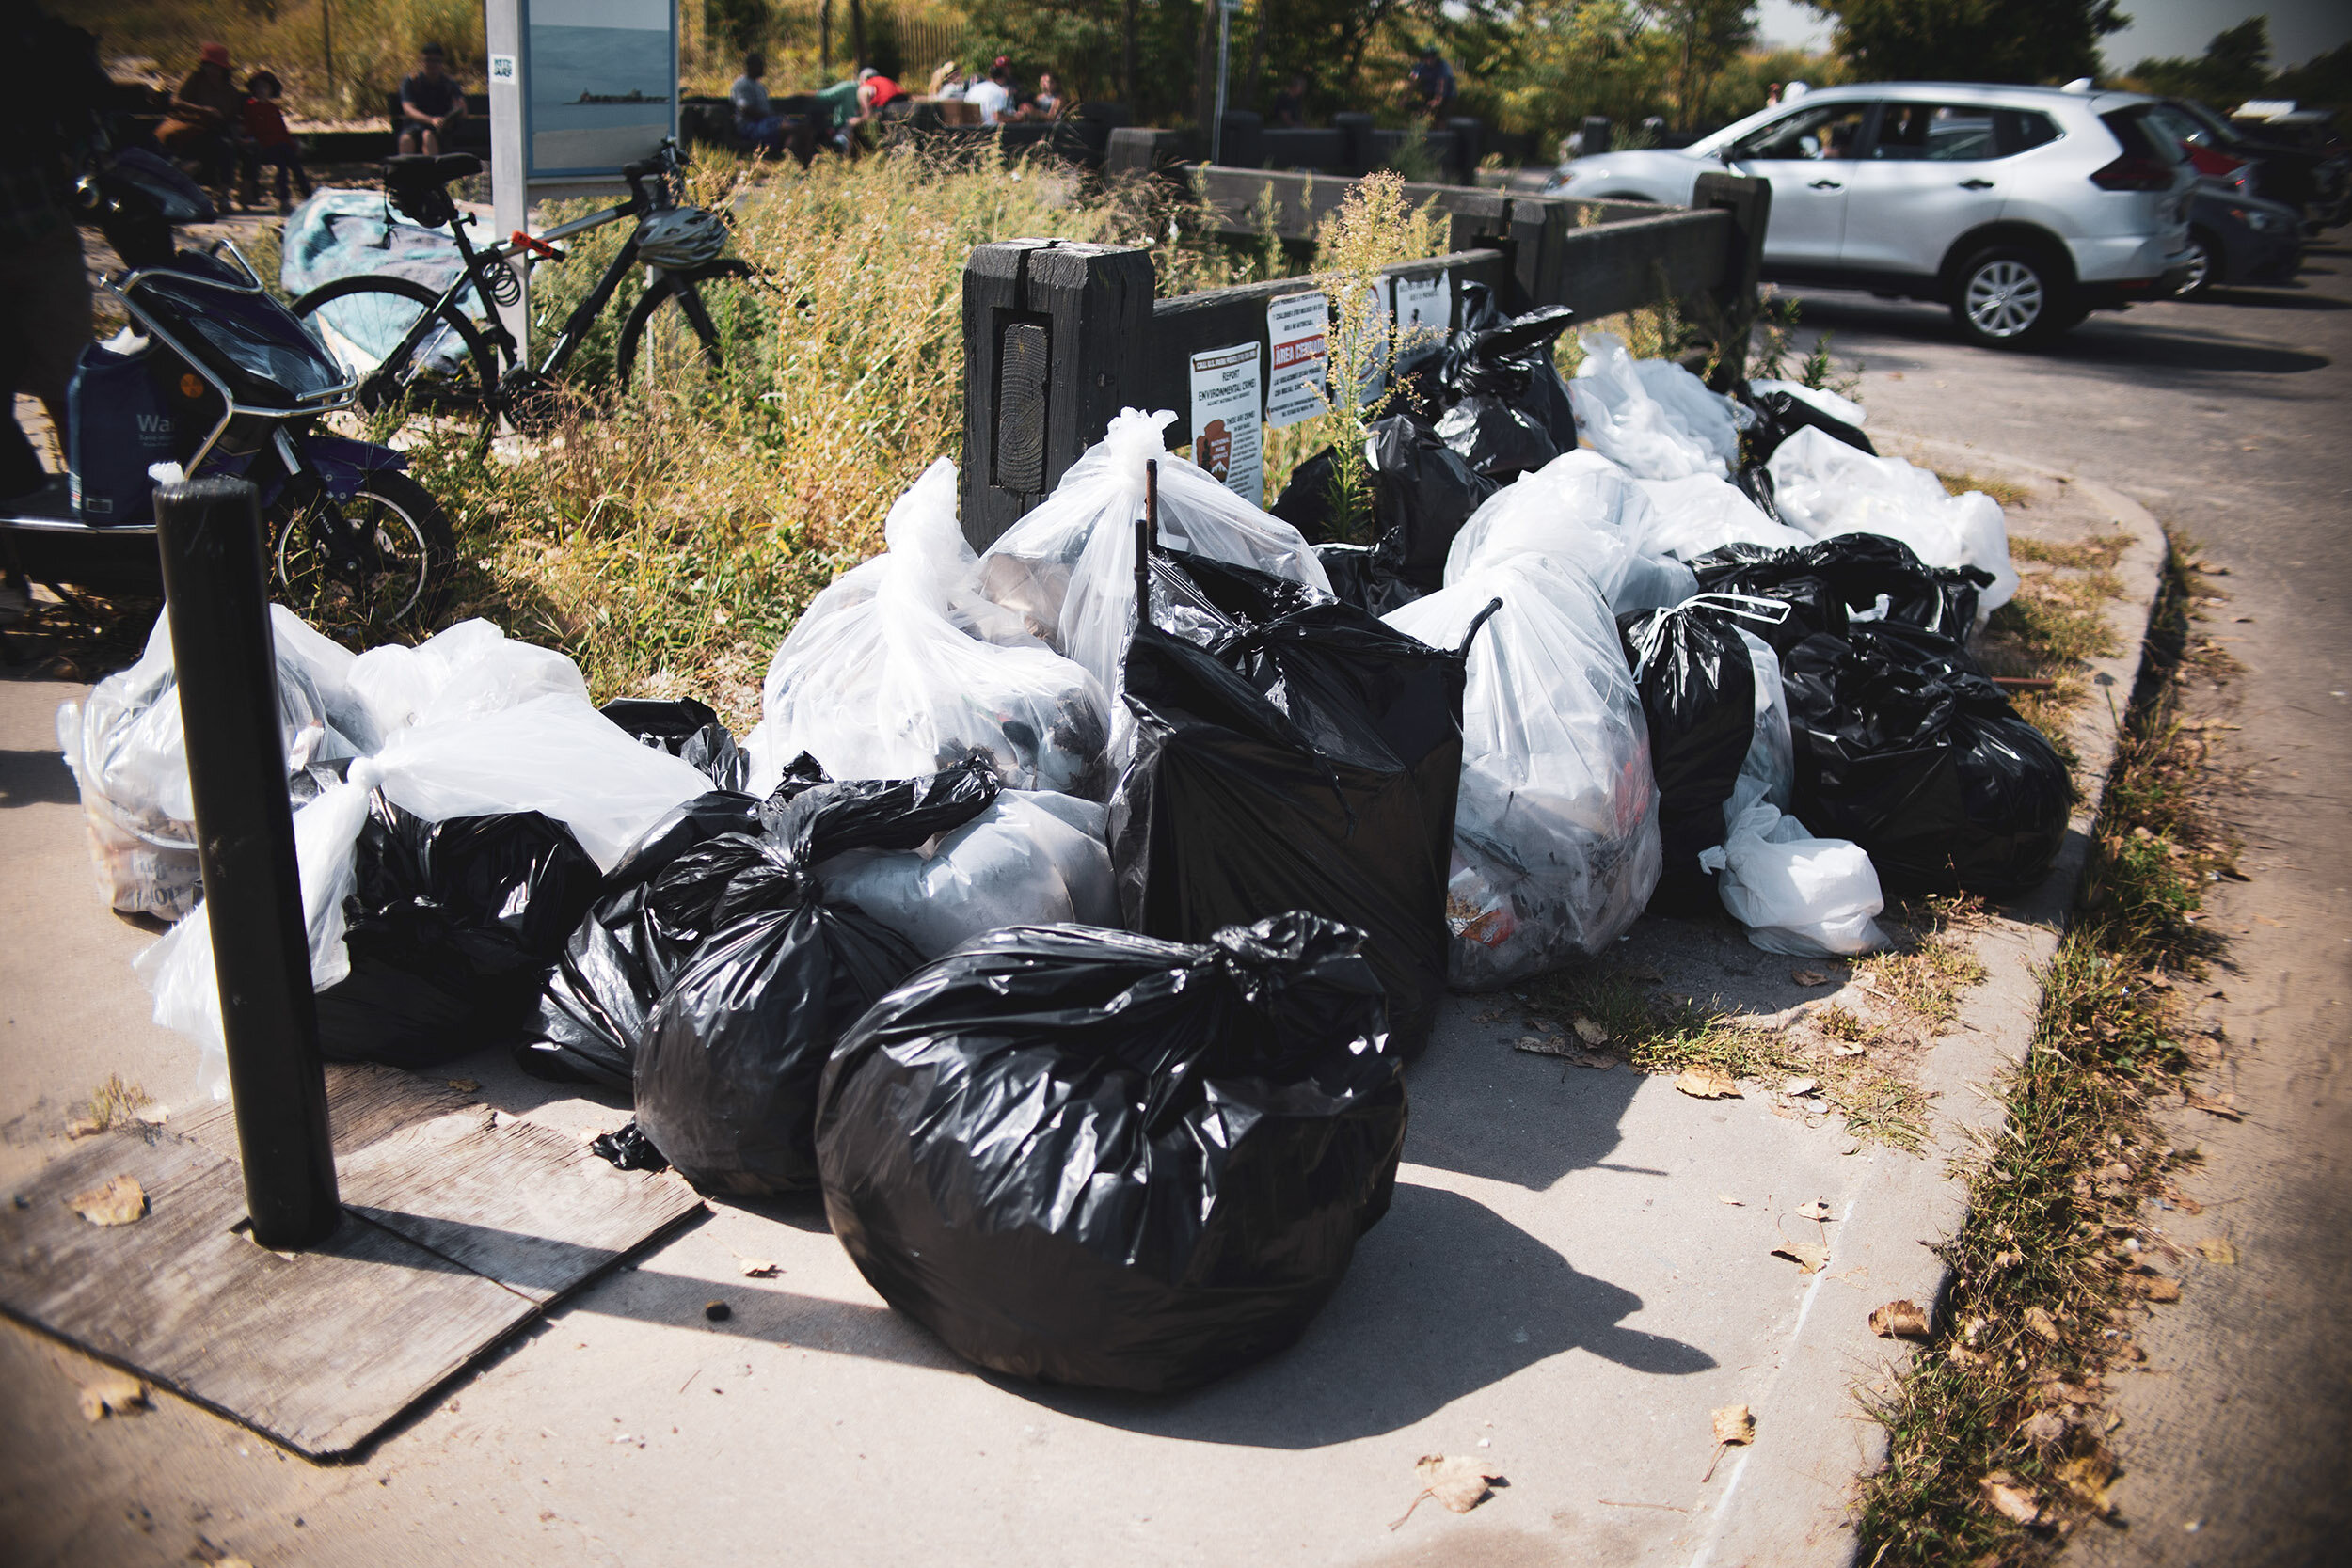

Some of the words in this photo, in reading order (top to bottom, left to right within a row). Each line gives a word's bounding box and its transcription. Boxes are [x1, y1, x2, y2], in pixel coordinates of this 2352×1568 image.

[1222, 368, 1240, 381] REPORT
[1198, 383, 1241, 401] ENVIRONMENTAL
[1211, 437, 1230, 447] NATIONAL
[1212, 452, 1228, 461] SERVICE
